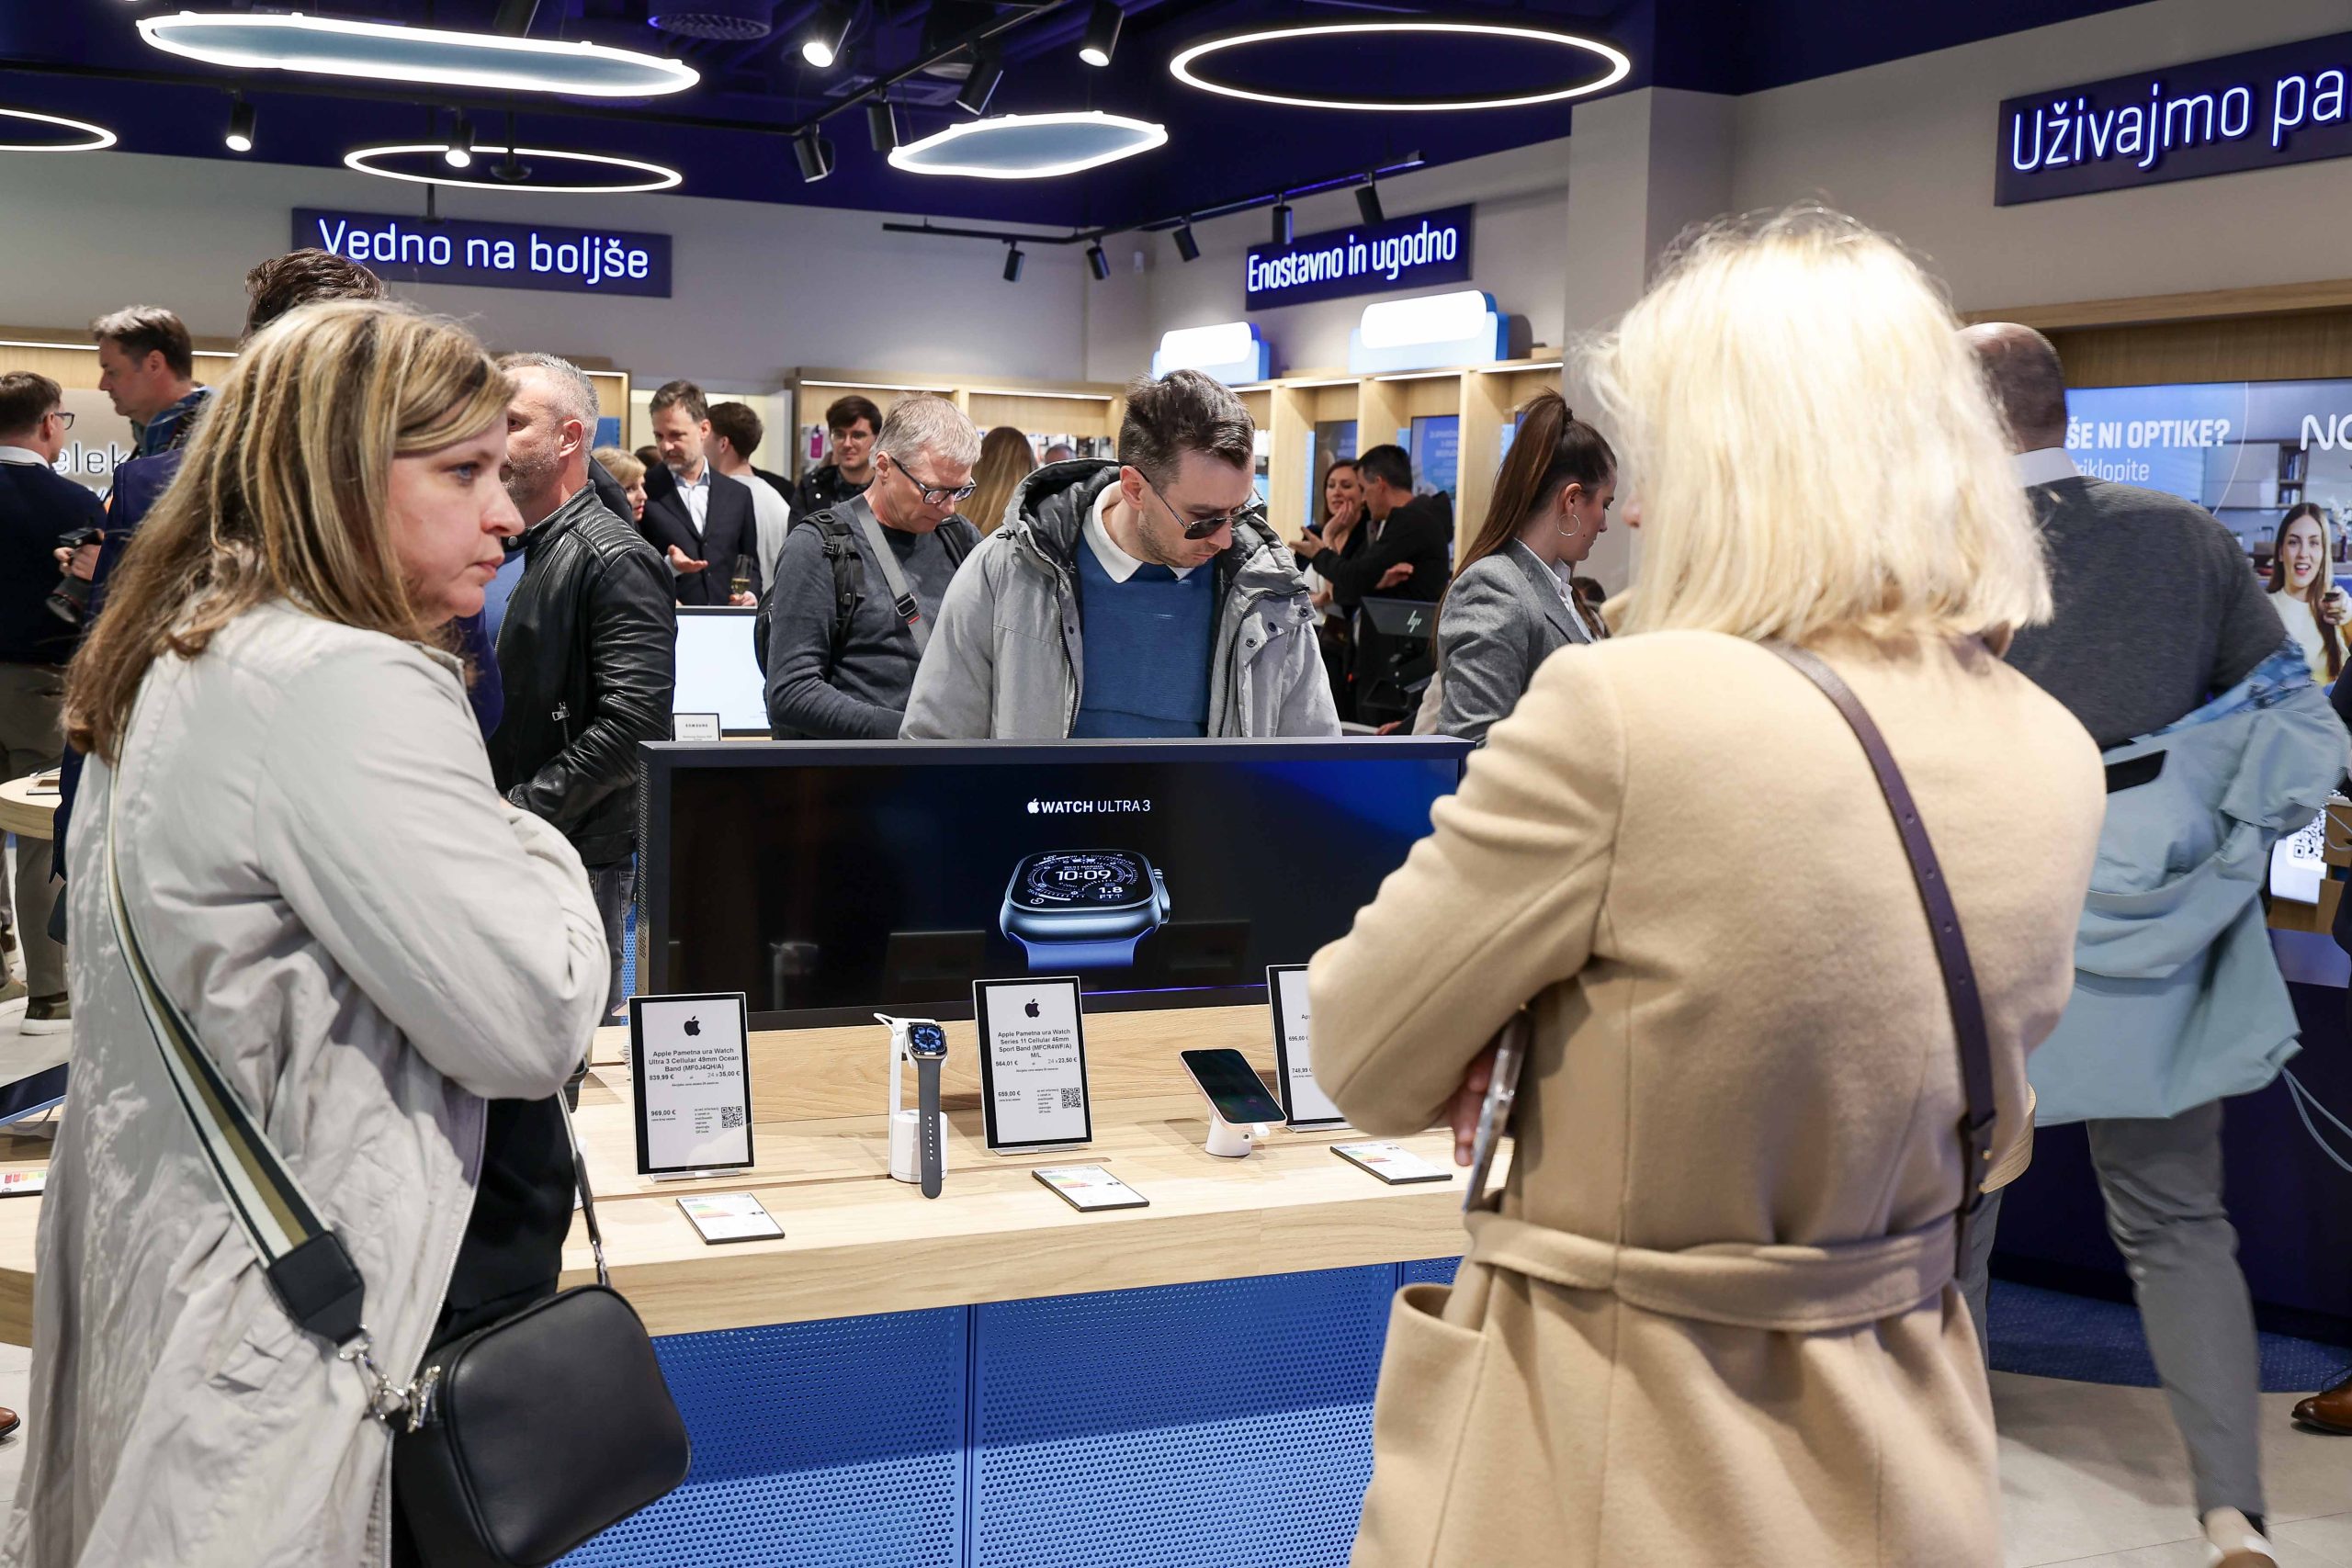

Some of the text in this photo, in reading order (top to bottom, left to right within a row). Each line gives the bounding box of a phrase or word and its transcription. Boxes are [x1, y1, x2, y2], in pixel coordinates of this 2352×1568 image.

[2013, 84, 2250, 171] Uživajmo
[318, 219, 649, 285] Vedno na boljše
[1248, 220, 1457, 292] Enostavno in ugodno
[2065, 415, 2231, 449] ŠE NI OPTIKE?
[1041, 799, 1151, 814] WATCH ULTRA 3
[1055, 869, 1112, 881] 10:09
[673, 1048, 701, 1056] Pametna
